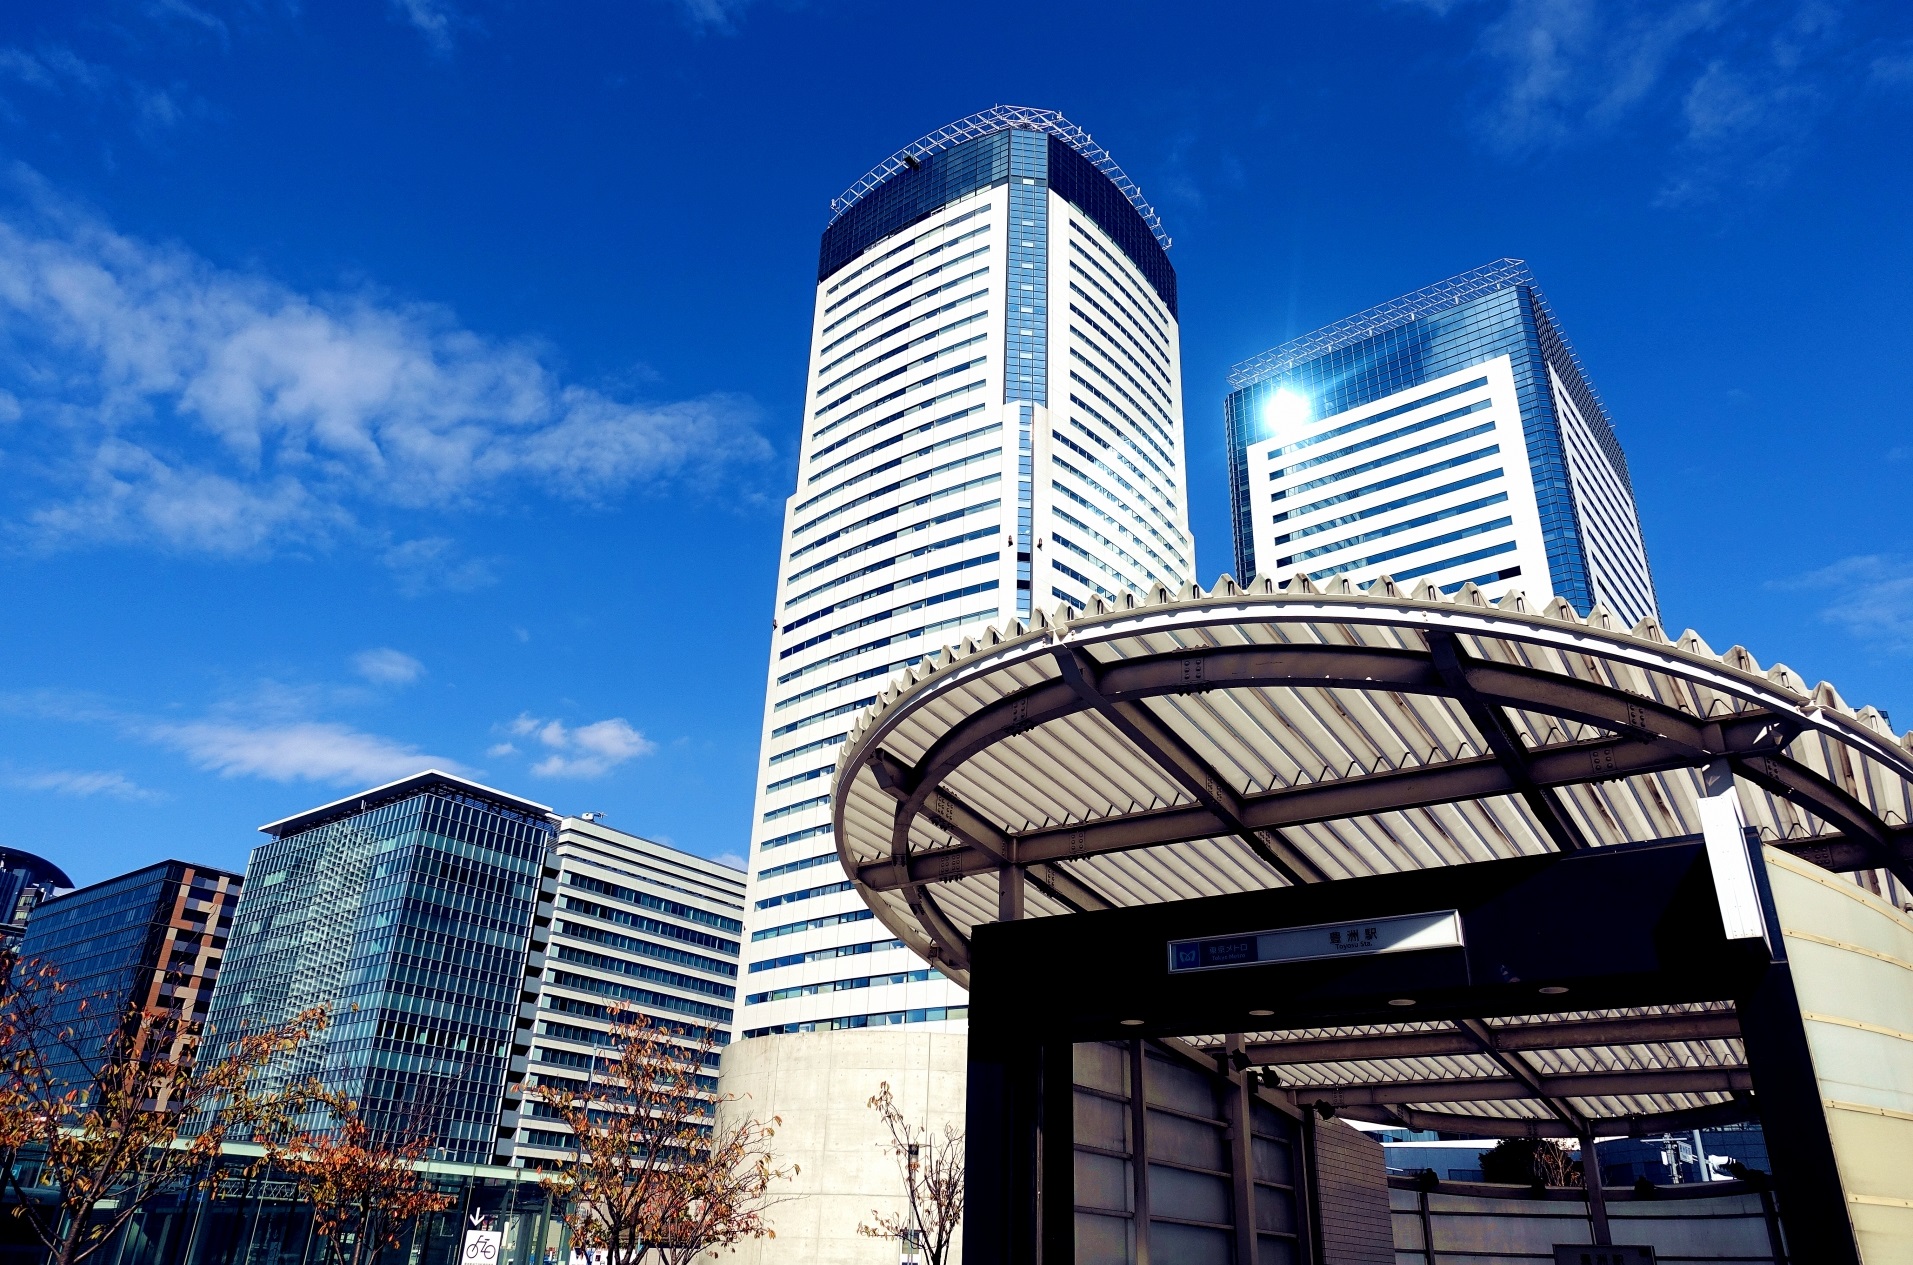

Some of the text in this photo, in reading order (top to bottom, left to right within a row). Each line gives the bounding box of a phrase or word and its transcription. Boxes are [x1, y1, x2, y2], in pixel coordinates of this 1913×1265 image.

[1329, 927, 1377, 943] 豊洲駅
[1209, 943, 1248, 954] 東京メトロ
[1335, 942, 1359, 950] Toyosu
